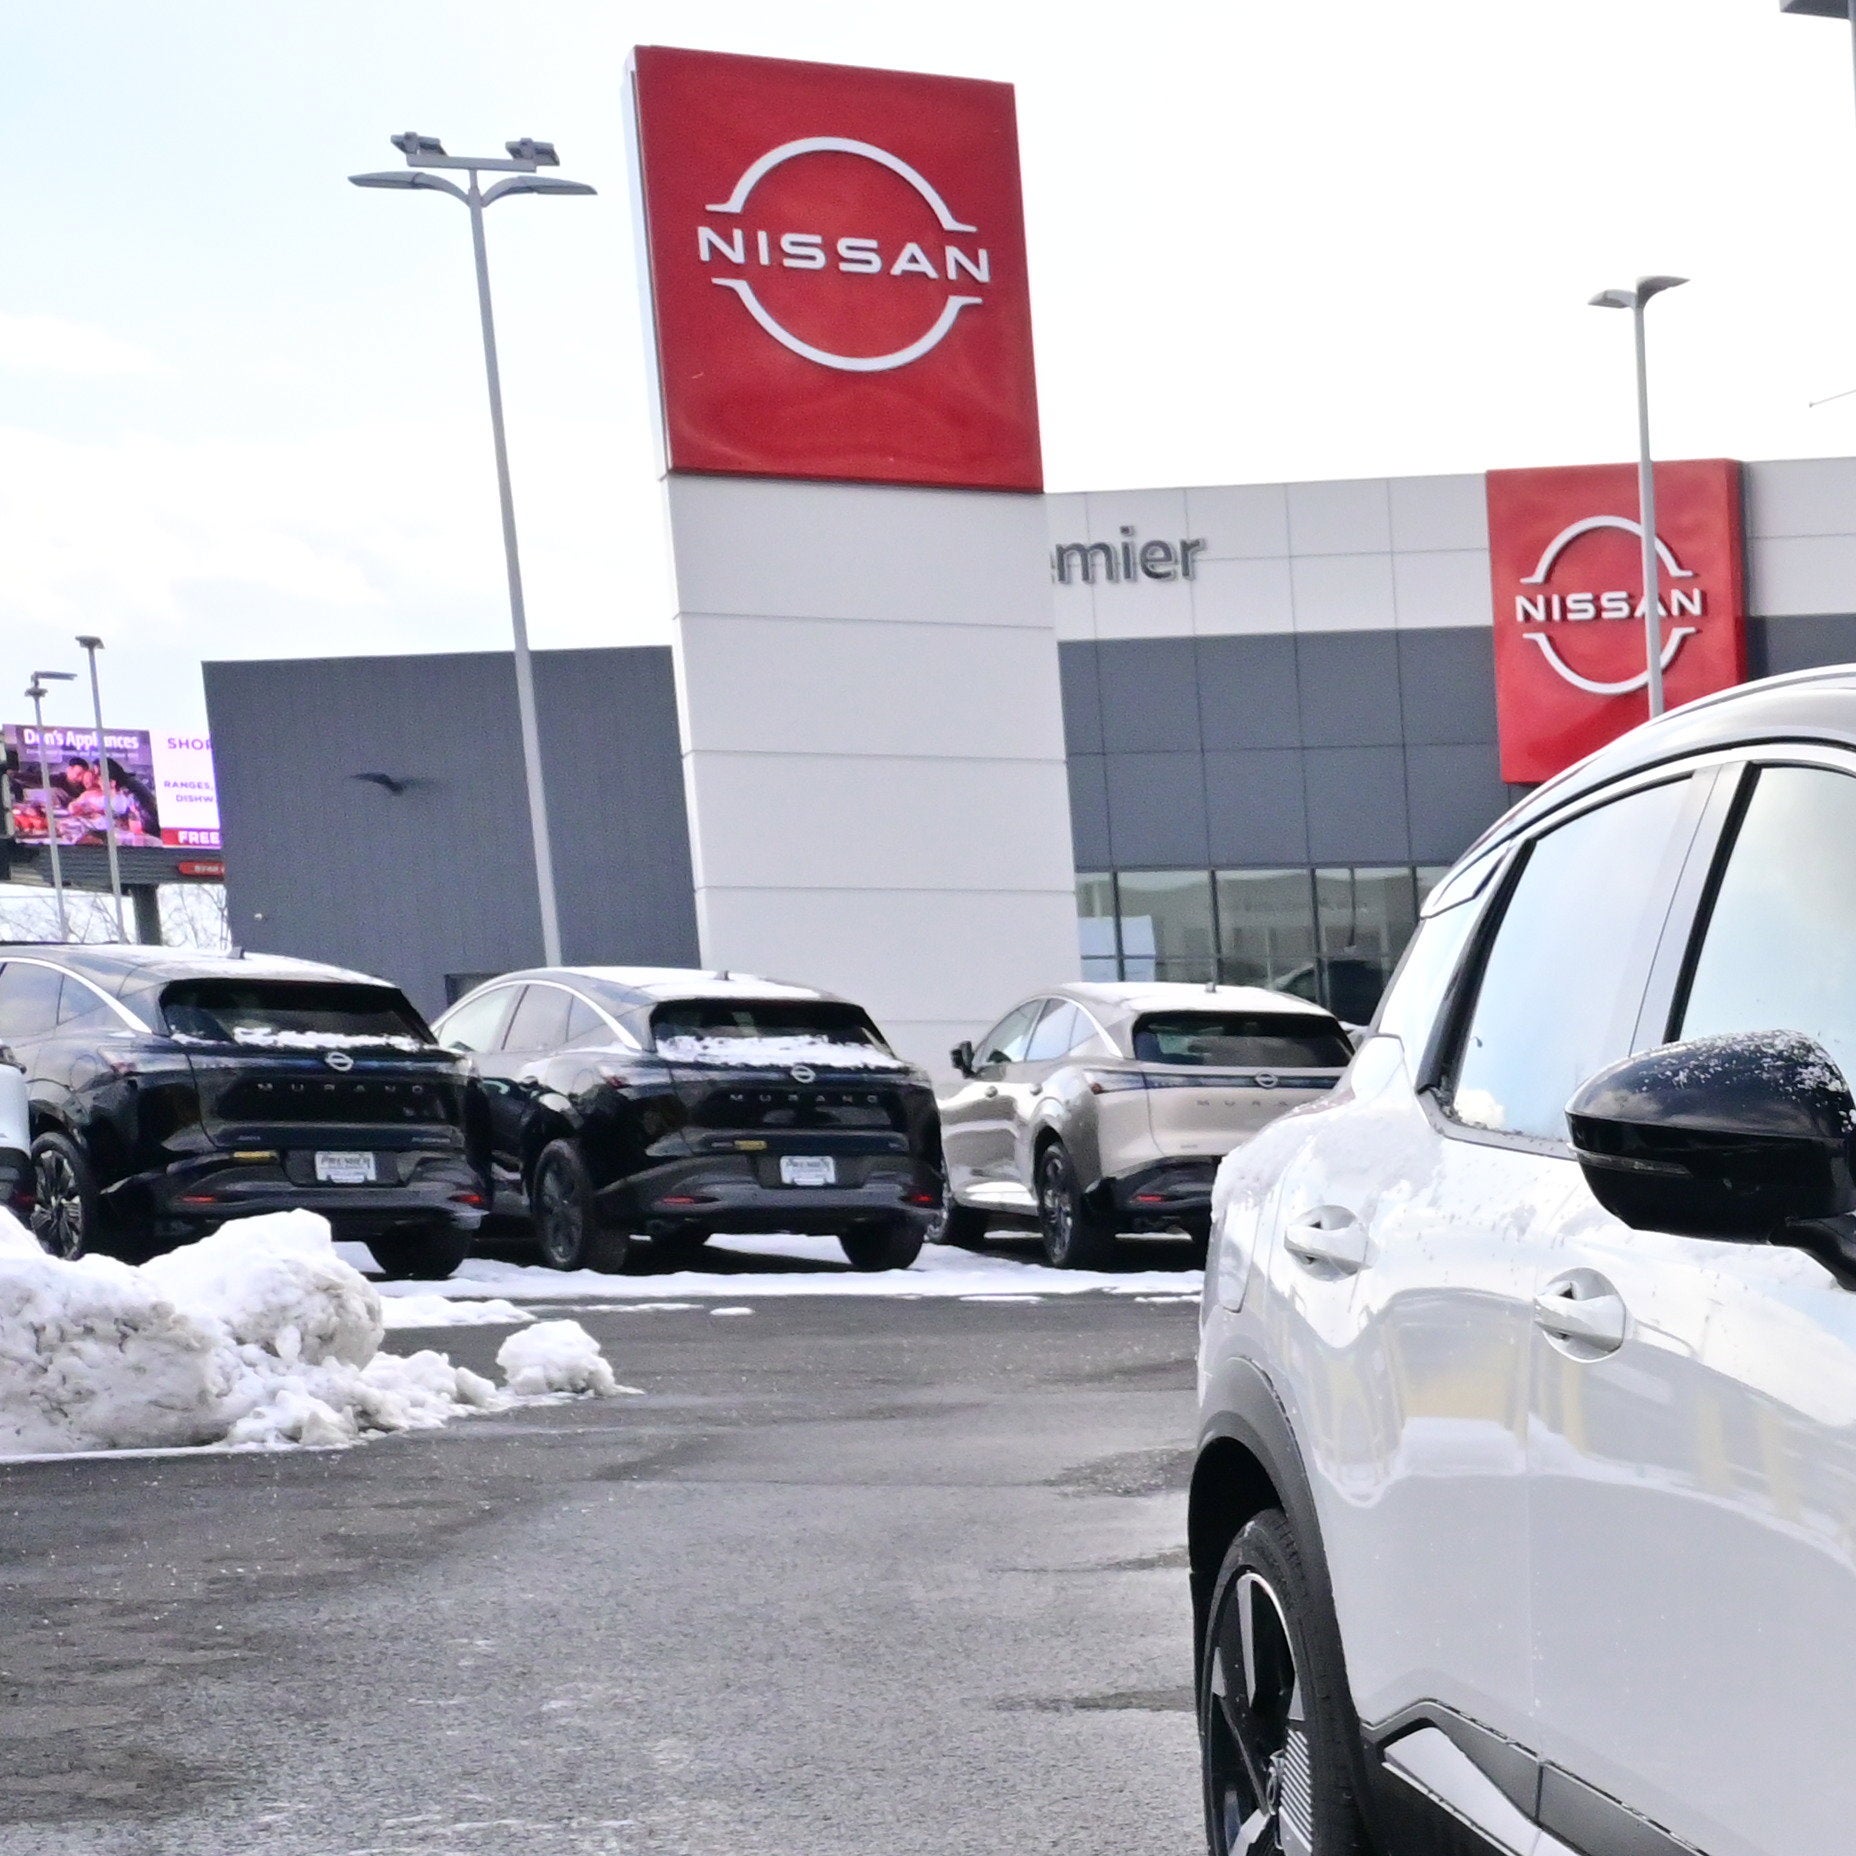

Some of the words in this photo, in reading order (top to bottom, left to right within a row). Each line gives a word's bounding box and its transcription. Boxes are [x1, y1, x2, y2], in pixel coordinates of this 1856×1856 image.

[697, 226, 991, 283] NISSAN
[1050, 525, 1207, 584] mier
[66, 731, 139, 750] Applnces
[177, 831, 221, 845] FREE
[257, 1082, 424, 1094] MURANO
[1197, 1099, 1309, 1108] MURA
